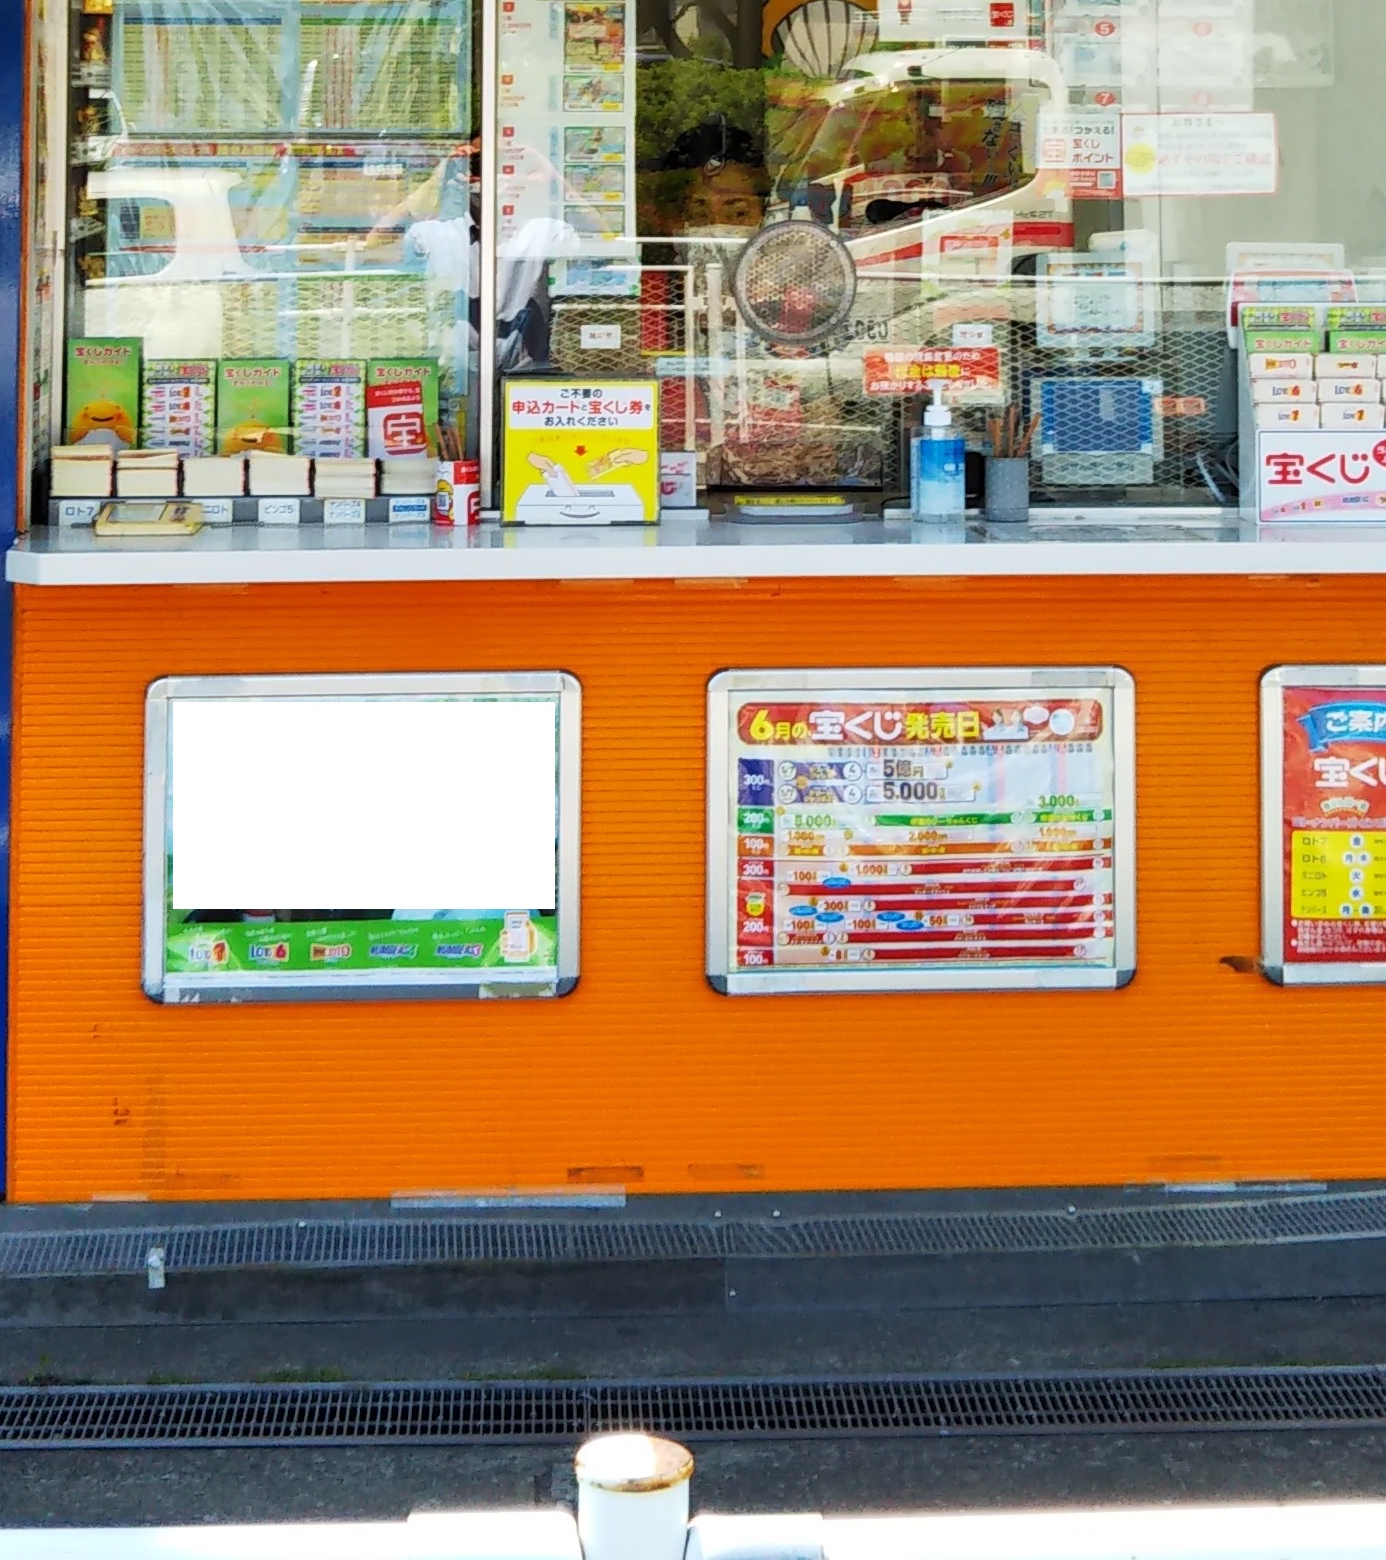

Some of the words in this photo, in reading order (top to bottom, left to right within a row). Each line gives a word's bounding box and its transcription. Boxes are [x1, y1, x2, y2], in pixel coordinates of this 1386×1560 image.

[544, 416, 619, 428] お入れください
[1265, 452, 1371, 485] 宝くじ
[64, 504, 95, 518] ロト7
[749, 709, 981, 741] 6月の宝くじ発売日
